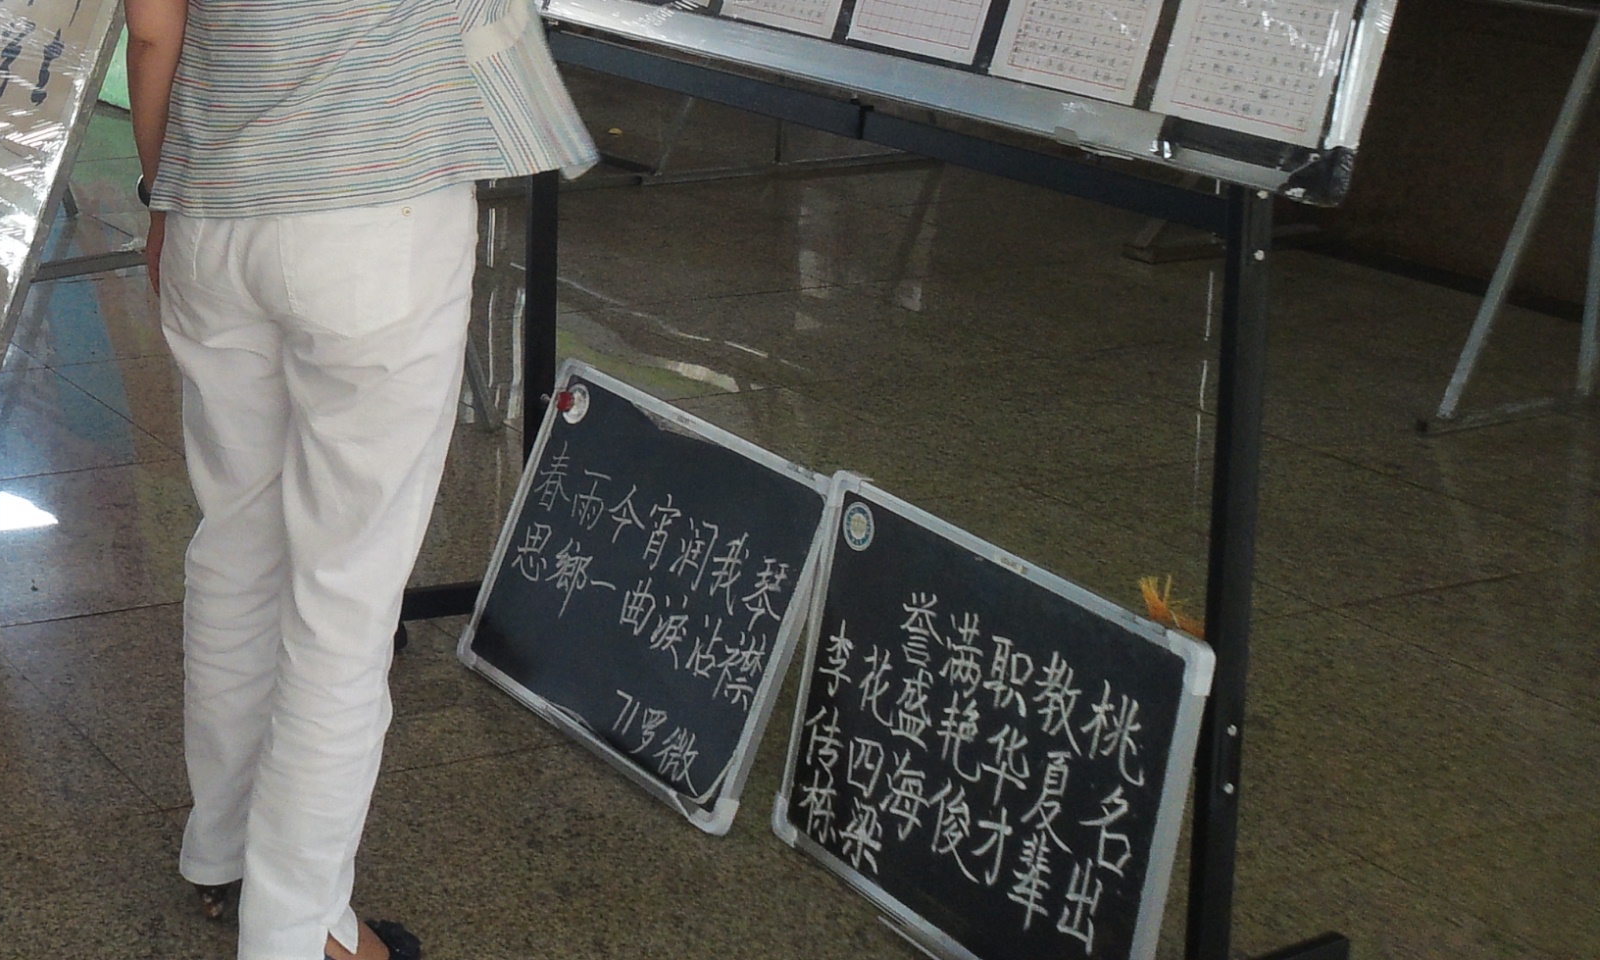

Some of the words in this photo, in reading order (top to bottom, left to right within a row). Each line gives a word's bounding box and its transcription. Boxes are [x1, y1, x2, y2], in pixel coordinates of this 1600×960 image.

[818, 619, 1133, 878] 李花盛艳华夏名
[902, 592, 1145, 787] 誉满职教桃
